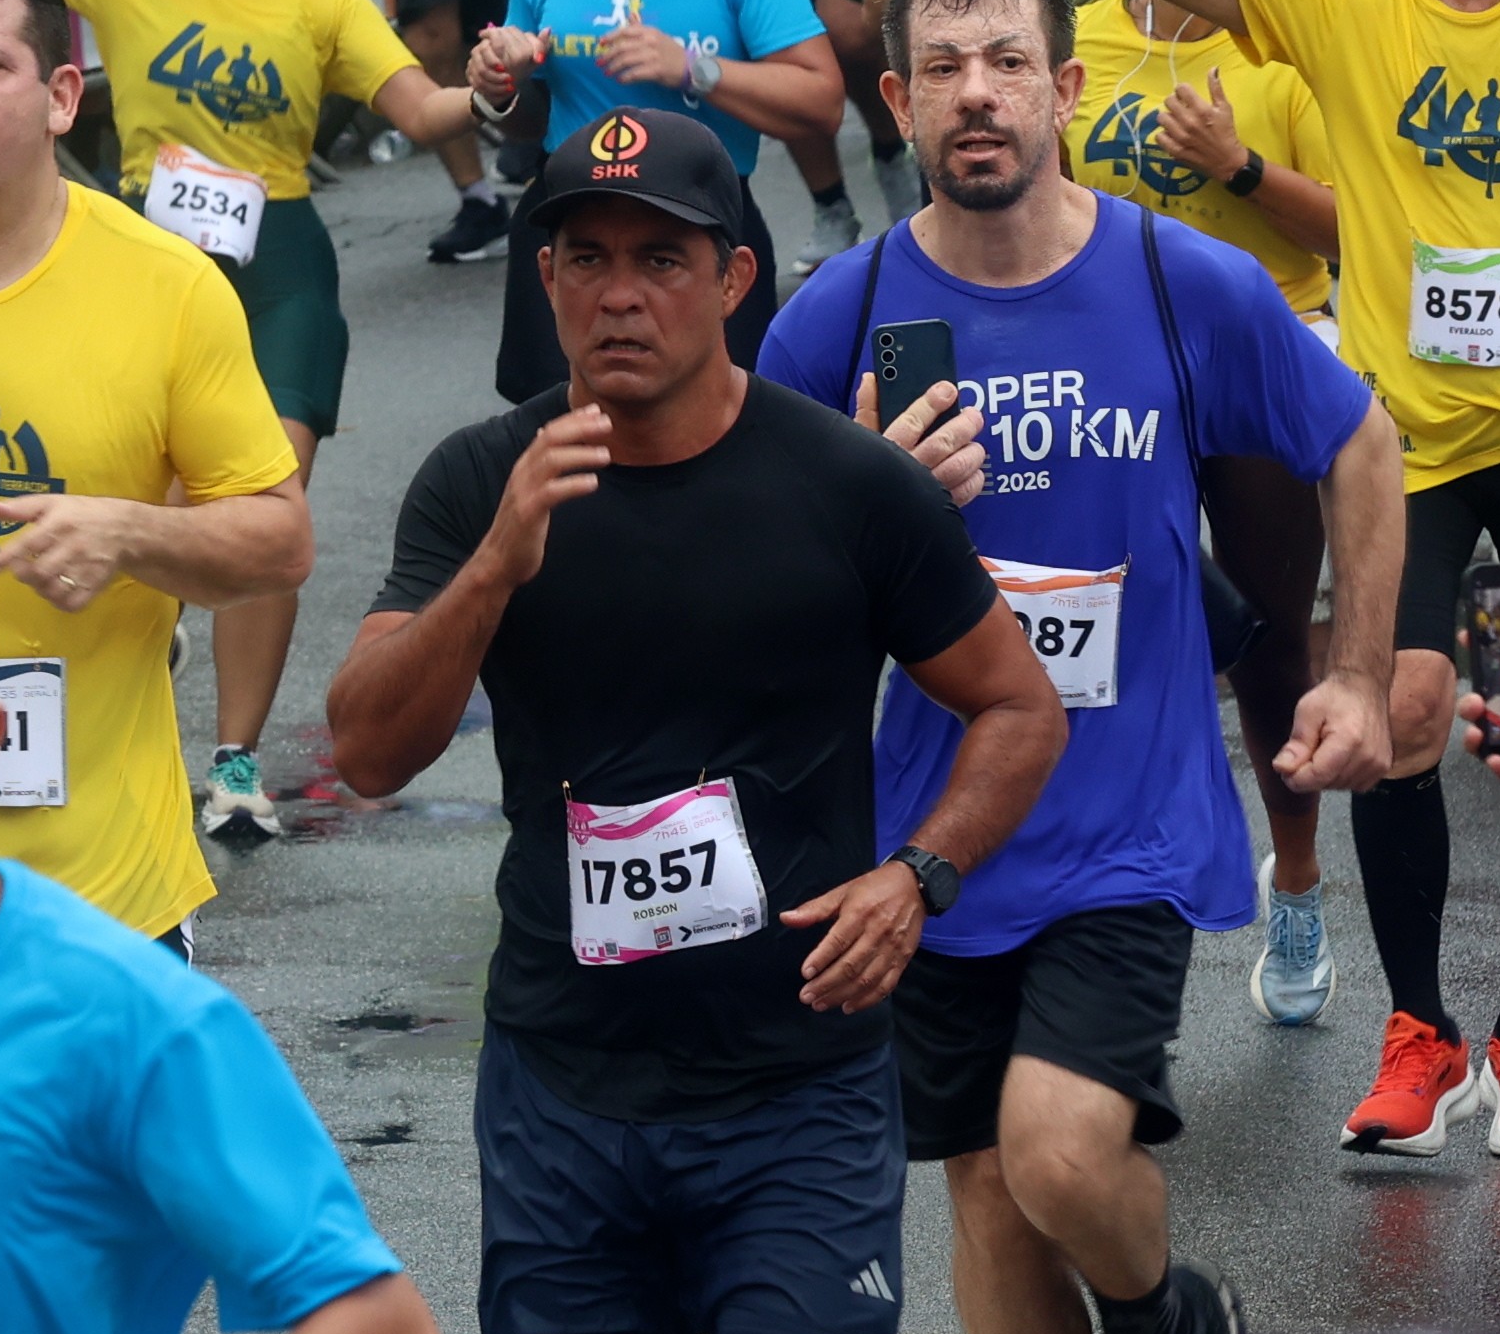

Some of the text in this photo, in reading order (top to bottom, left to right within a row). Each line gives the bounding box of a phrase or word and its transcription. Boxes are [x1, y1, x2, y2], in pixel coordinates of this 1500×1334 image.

[591, 163, 641, 180] SHK
[169, 181, 249, 227] 2534
[1448, 326, 1494, 336] EVERALDO
[957, 371, 1085, 415] OPER
[990, 406, 1160, 463] 10 KM
[996, 470, 1052, 495] 2026
[652, 822, 690, 843] 7h45
[581, 838, 717, 906] 17857
[633, 903, 679, 921] ROBSON
[692, 921, 730, 936] terracom
